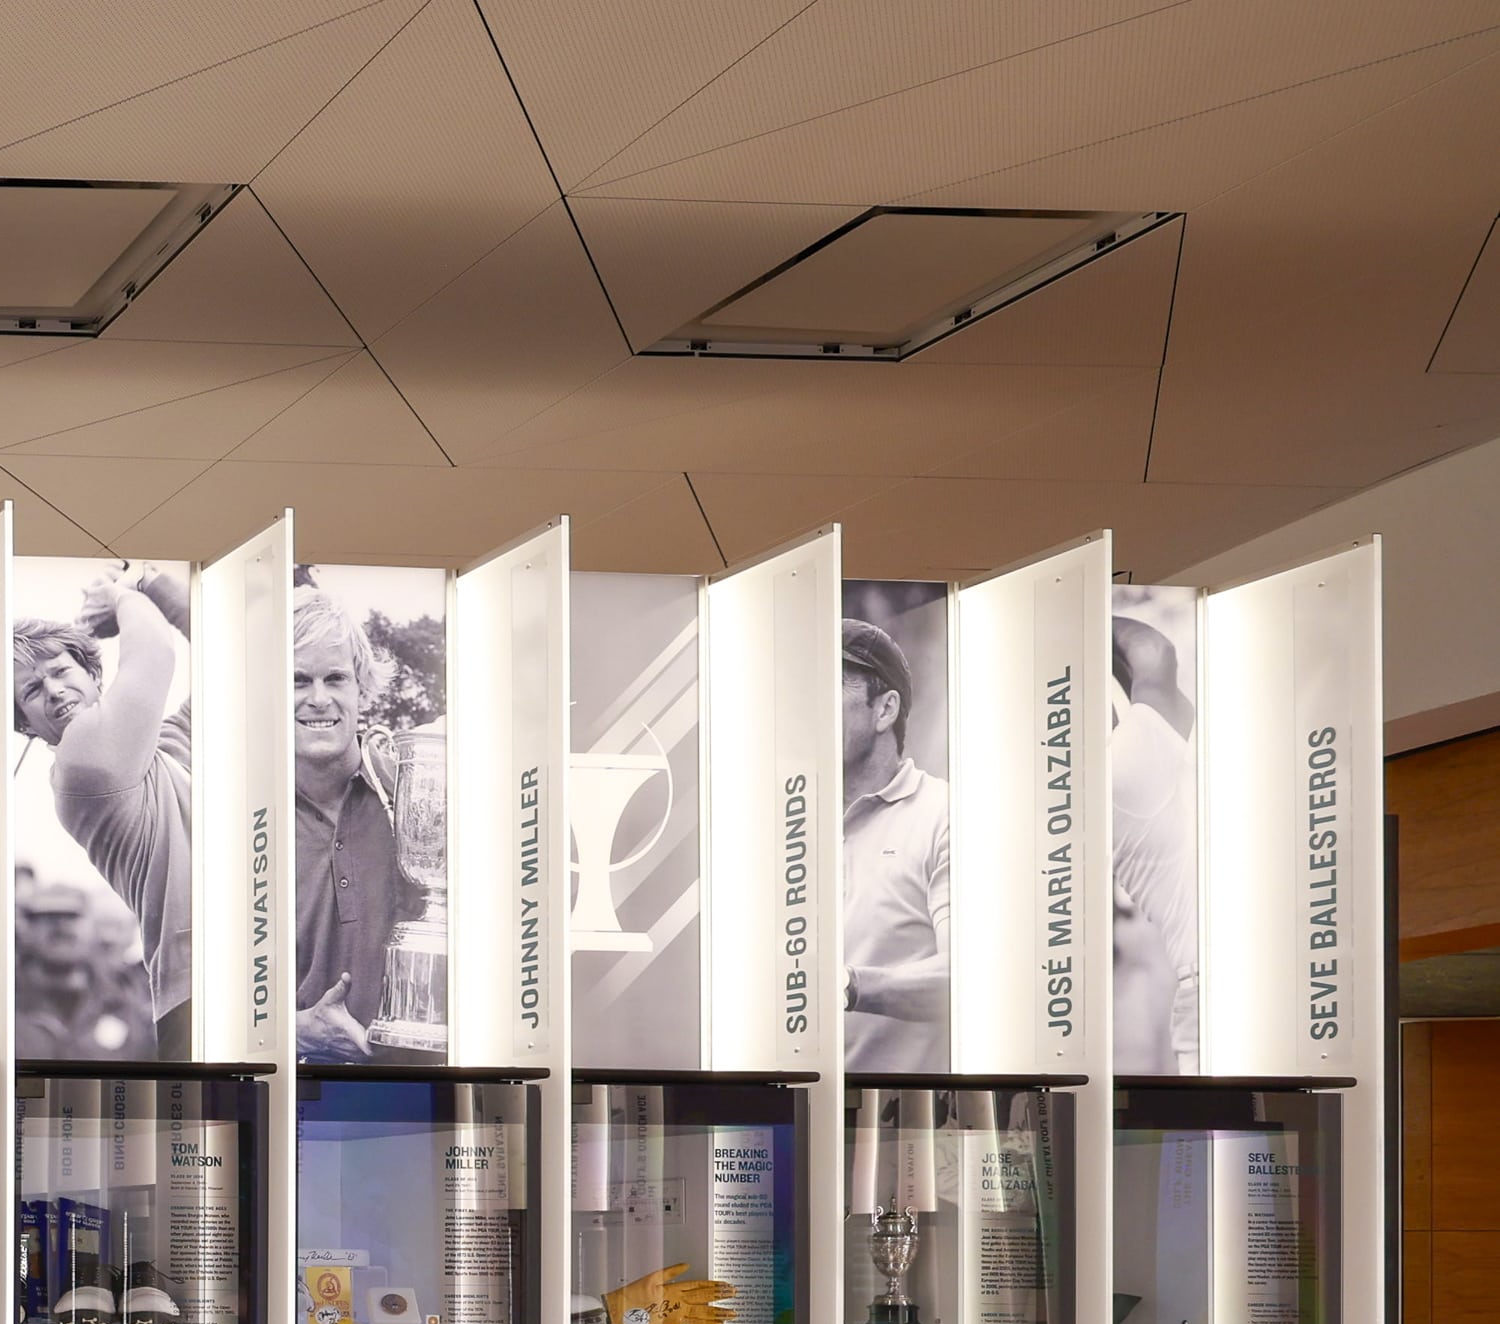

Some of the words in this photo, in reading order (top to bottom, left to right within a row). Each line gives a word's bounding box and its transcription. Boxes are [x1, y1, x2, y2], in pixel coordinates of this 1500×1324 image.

[1041, 665, 1072, 835] OLAZÁBAL
[520, 766, 539, 887] MILLER
[785, 774, 807, 906] ROUNDS
[1308, 726, 1338, 951] BALLESTEROS
[253, 806, 268, 947] WATSON
[1041, 842, 1072, 947] MARÍA
[254, 954, 268, 1028] TOM
[520, 897, 538, 1029] JOHNNY
[786, 916, 807, 1034] SUB-60
[1041, 956, 1072, 1037] JOSÉ
[1310, 958, 1338, 1040] SEVE
[171, 1143, 198, 1154] TOM
[171, 1156, 222, 1167] WATSON
[445, 1146, 495, 1157] JOHNNY
[445, 1159, 489, 1170] MILLER
[715, 1148, 769, 1159] BREAKING
[715, 1161, 735, 1171] THE
[738, 1161, 773, 1171] MAGIC
[715, 1173, 760, 1183] NUMBER
[982, 1151, 1012, 1164] JOSÉ
[1248, 1152, 1276, 1163] SEVE
